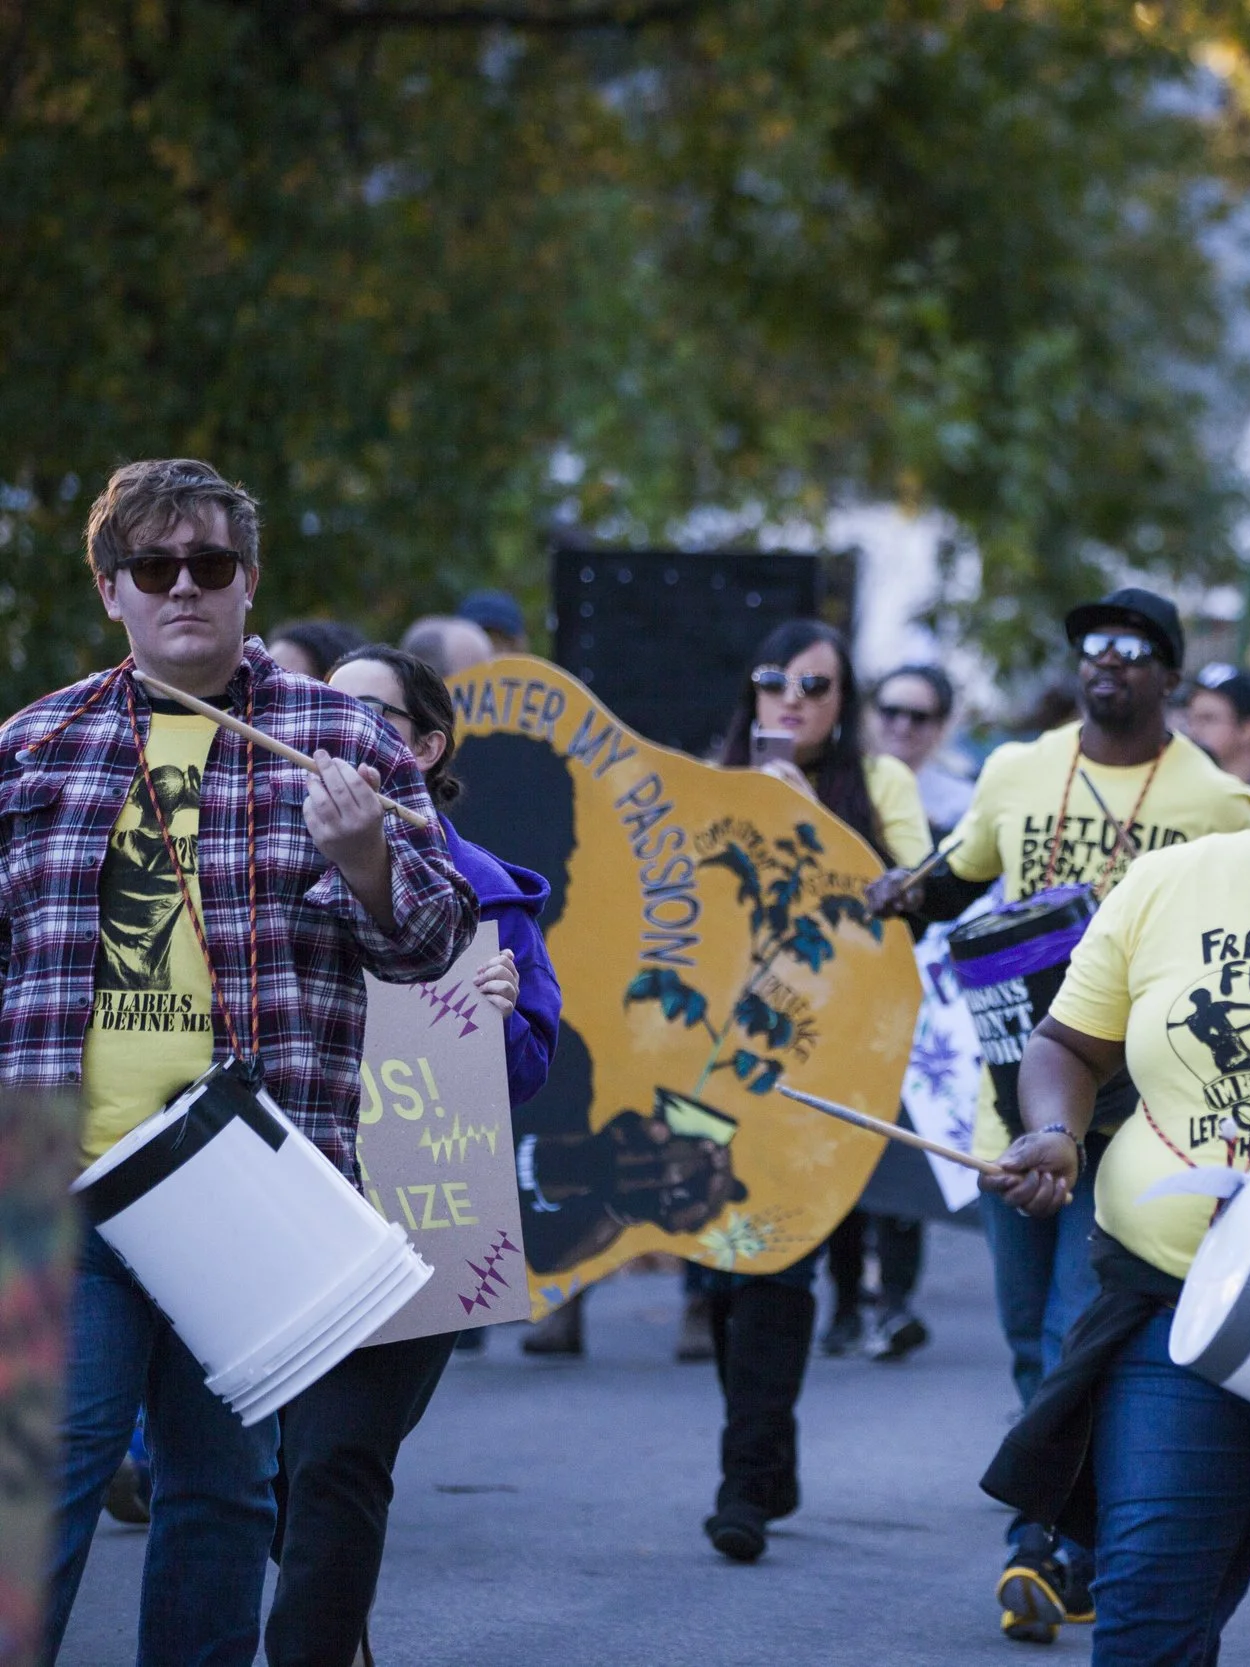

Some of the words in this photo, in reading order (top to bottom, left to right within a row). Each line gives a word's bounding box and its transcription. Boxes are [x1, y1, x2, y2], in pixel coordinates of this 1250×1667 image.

[567, 709, 638, 780] MY
[614, 771, 702, 967] PASSION
[118, 993, 193, 1013] LABELS
[101, 1012, 175, 1032] DEFINE
[180, 1013, 212, 1032] ME
